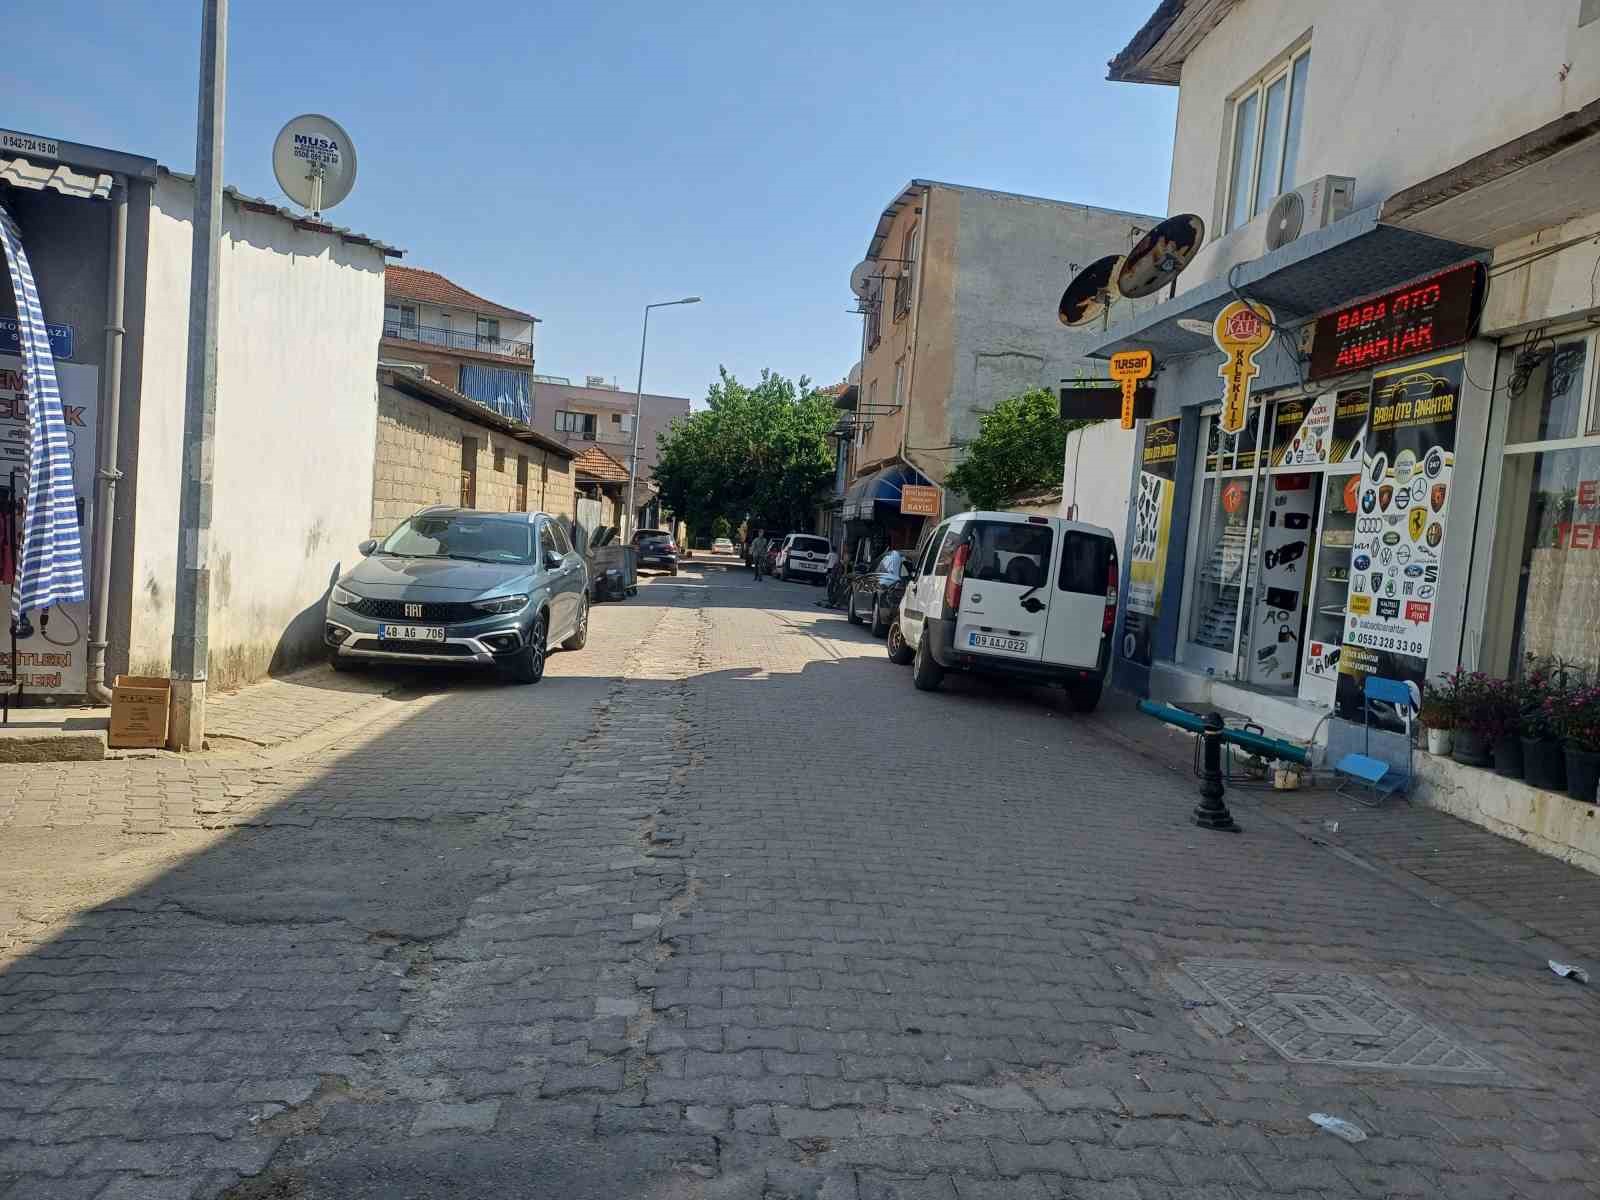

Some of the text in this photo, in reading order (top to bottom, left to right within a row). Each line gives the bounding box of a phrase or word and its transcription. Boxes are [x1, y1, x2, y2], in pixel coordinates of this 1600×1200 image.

[47, 143, 56, 154] 00
[294, 134, 338, 151] MUSA
[1337, 284, 1440, 334] BABA OTO
[1224, 317, 1263, 338] KALE
[1336, 320, 1432, 367] ANAHTAR
[1374, 406, 1394, 425] BABA
[1395, 402, 1412, 420] OTO
[1413, 394, 1454, 419] ANAHTAR
[404, 604, 423, 617] FIAT
[386, 627, 444, 639] 48 AG 706
[976, 636, 987, 645] 09
[1008, 640, 1025, 651] 022
[1358, 632, 1422, 654] 0552 328 33 09
